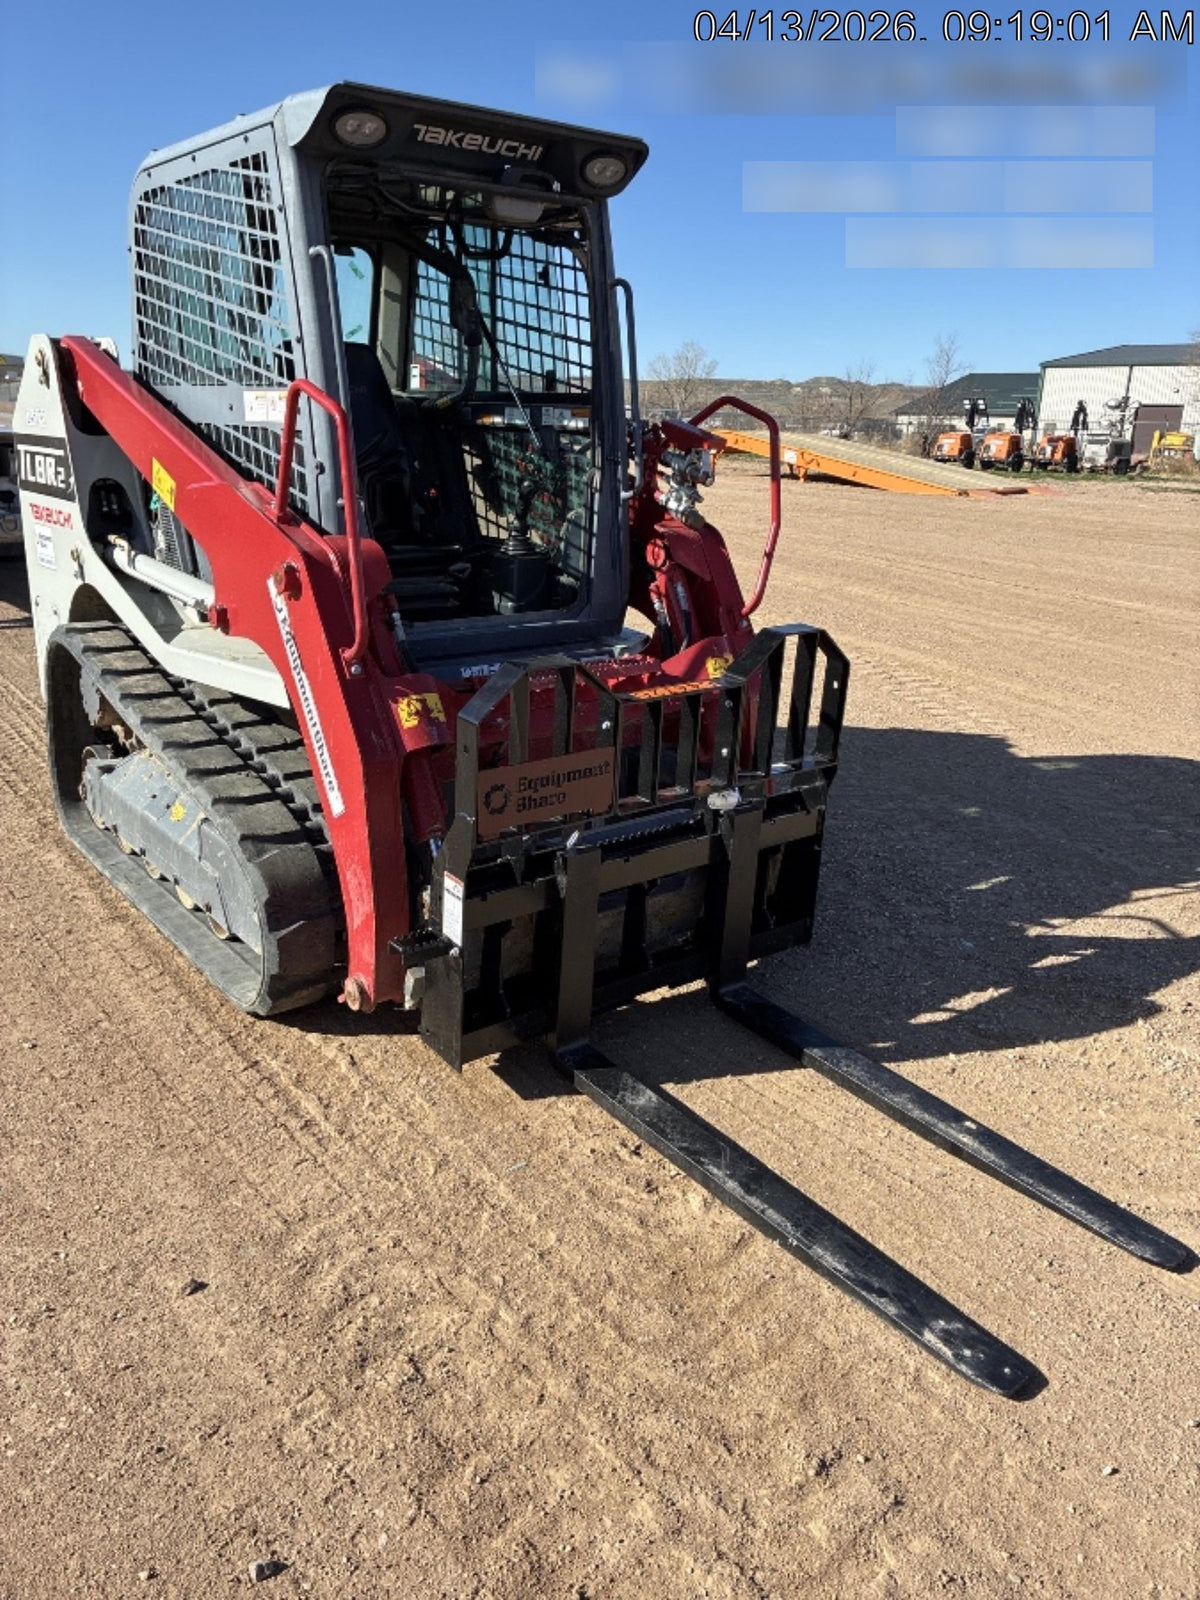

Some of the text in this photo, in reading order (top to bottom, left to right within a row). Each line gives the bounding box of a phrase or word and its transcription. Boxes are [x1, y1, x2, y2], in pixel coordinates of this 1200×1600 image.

[413, 123, 543, 161] TAKEUCHI
[517, 760, 611, 793] Equipment
[516, 792, 567, 813] Share
